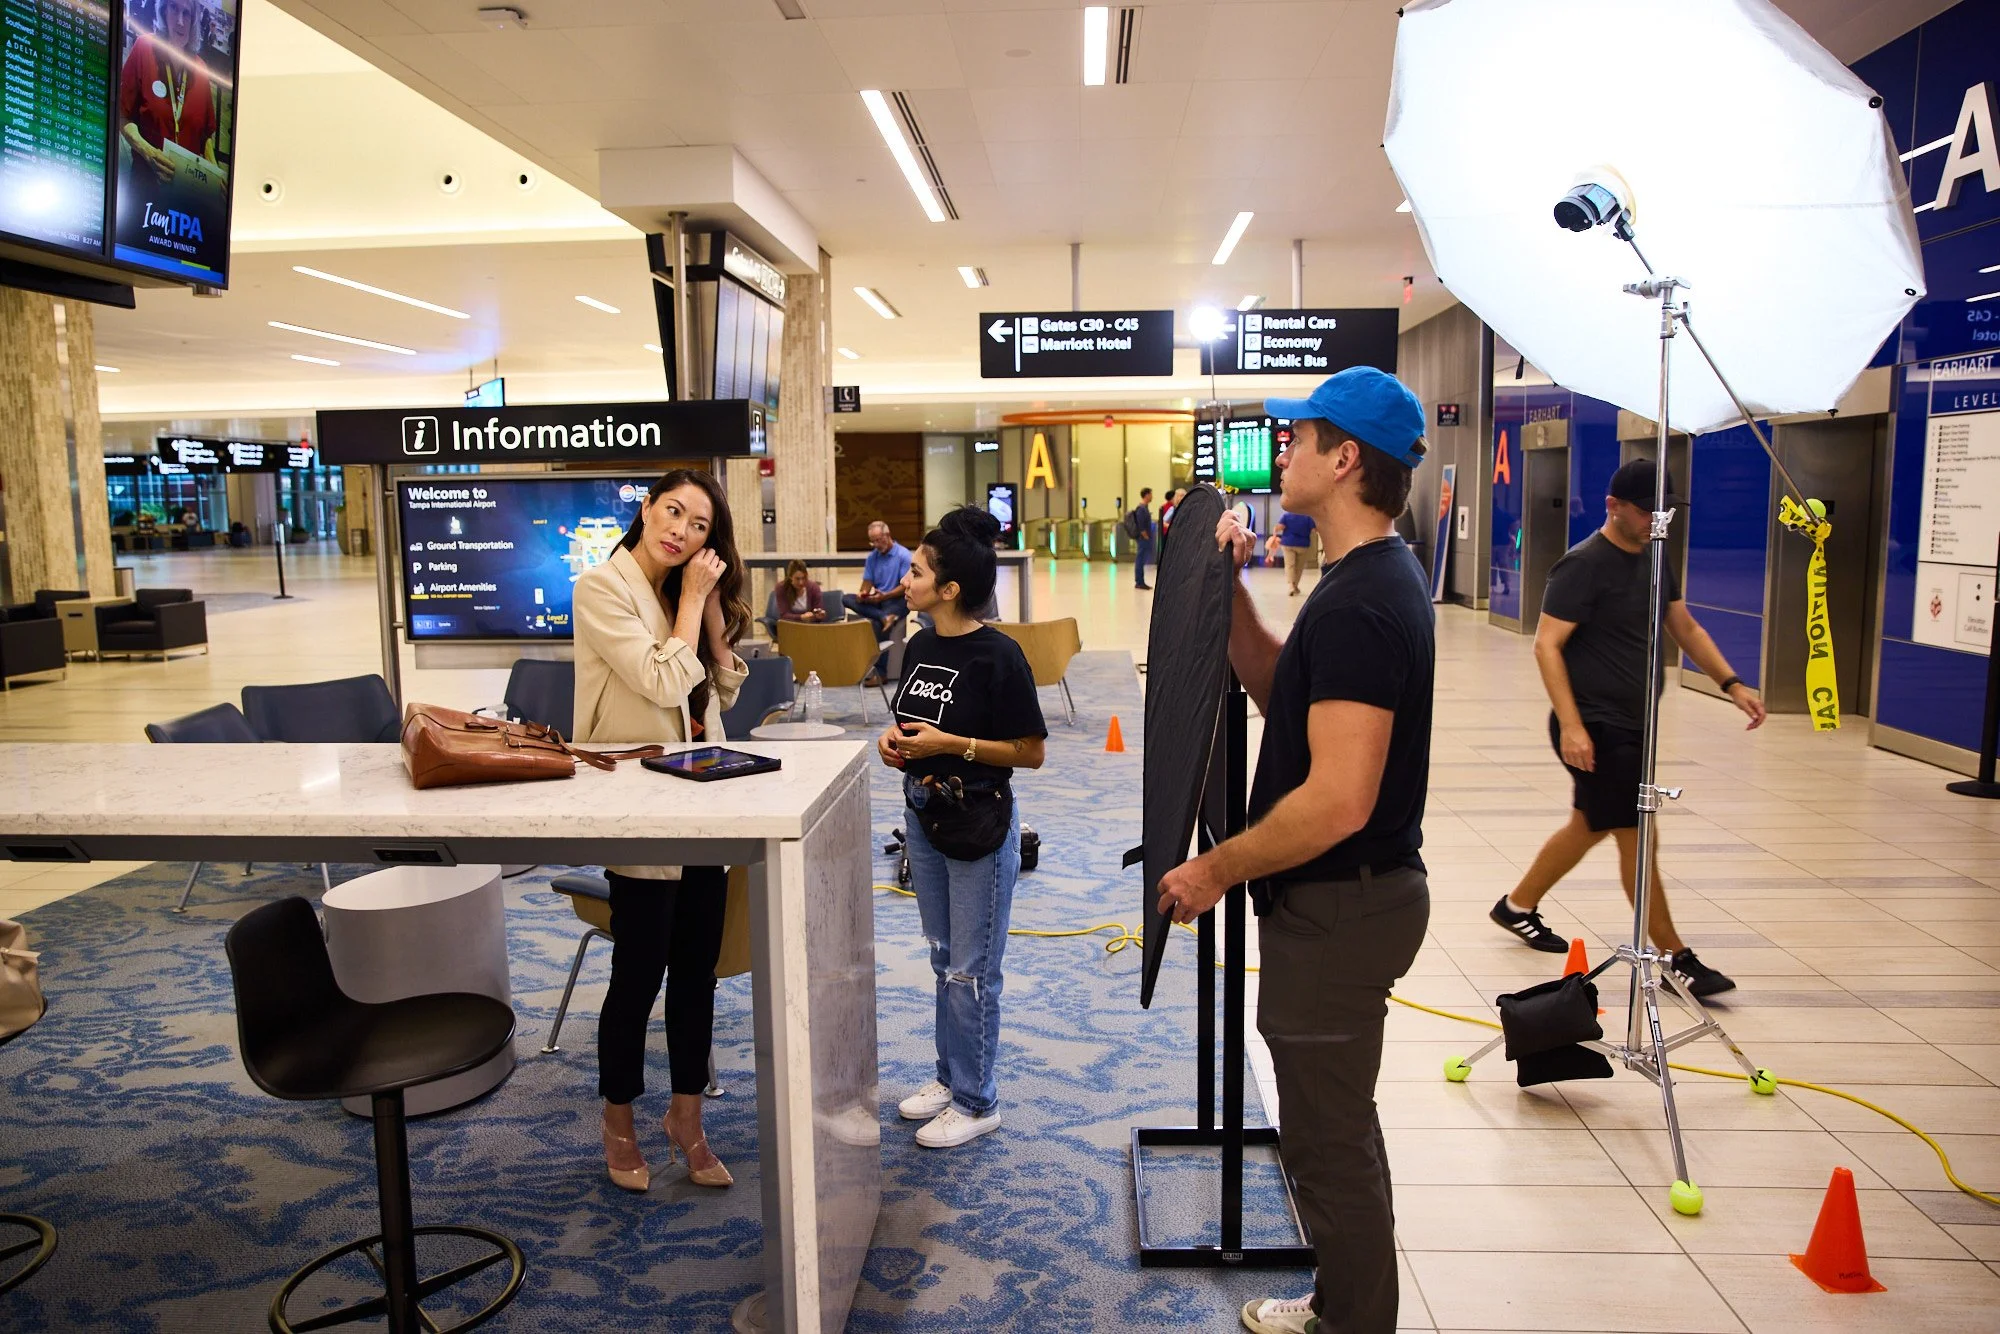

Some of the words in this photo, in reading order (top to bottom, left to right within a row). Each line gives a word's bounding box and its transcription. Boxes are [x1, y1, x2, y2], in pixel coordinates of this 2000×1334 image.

[5, 16, 34, 36] Southwest
[5, 49, 34, 68] Southwest
[14, 42, 37, 58] DELTA
[5, 60, 34, 78] Southwest
[5, 71, 33, 89] Southwest
[5, 82, 33, 99] Southwest
[5, 92, 33, 110] Southwest
[5, 103, 33, 120] Southwest
[5, 125, 33, 141] Southwest
[5, 135, 33, 152] Southwest
[1932, 80, 2000, 211] A
[168, 209, 204, 243] TPA
[93, 239, 101, 247] AM
[149, 235, 172, 248] AWARD
[173, 242, 197, 255] WINNER
[1040, 319, 1078, 332] Gates
[1080, 318, 1105, 332] C30
[1114, 317, 1140, 331] C45
[1263, 315, 1306, 330] Rental
[1307, 316, 1337, 330] Cars
[1040, 337, 1095, 350] Marriott
[1096, 336, 1132, 350] Hotel
[1263, 335, 1323, 352] Economy
[1262, 353, 1302, 368] Public
[1303, 354, 1328, 368] Bus
[1934, 355, 1994, 378] EARHART
[1954, 392, 1997, 409] LEVEL
[452, 416, 662, 451] Information
[1026, 433, 1056, 490] A
[1493, 429, 1511, 484] A
[407, 487, 470, 500] Welcome
[472, 487, 488, 500] to
[408, 501, 430, 510] Tampa
[431, 501, 472, 509] International
[473, 500, 497, 509] Airport
[427, 541, 457, 551] Ground
[458, 541, 514, 551] Transportation
[428, 562, 458, 573] Parking
[430, 583, 457, 593] Airport
[458, 582, 497, 592] Amenities
